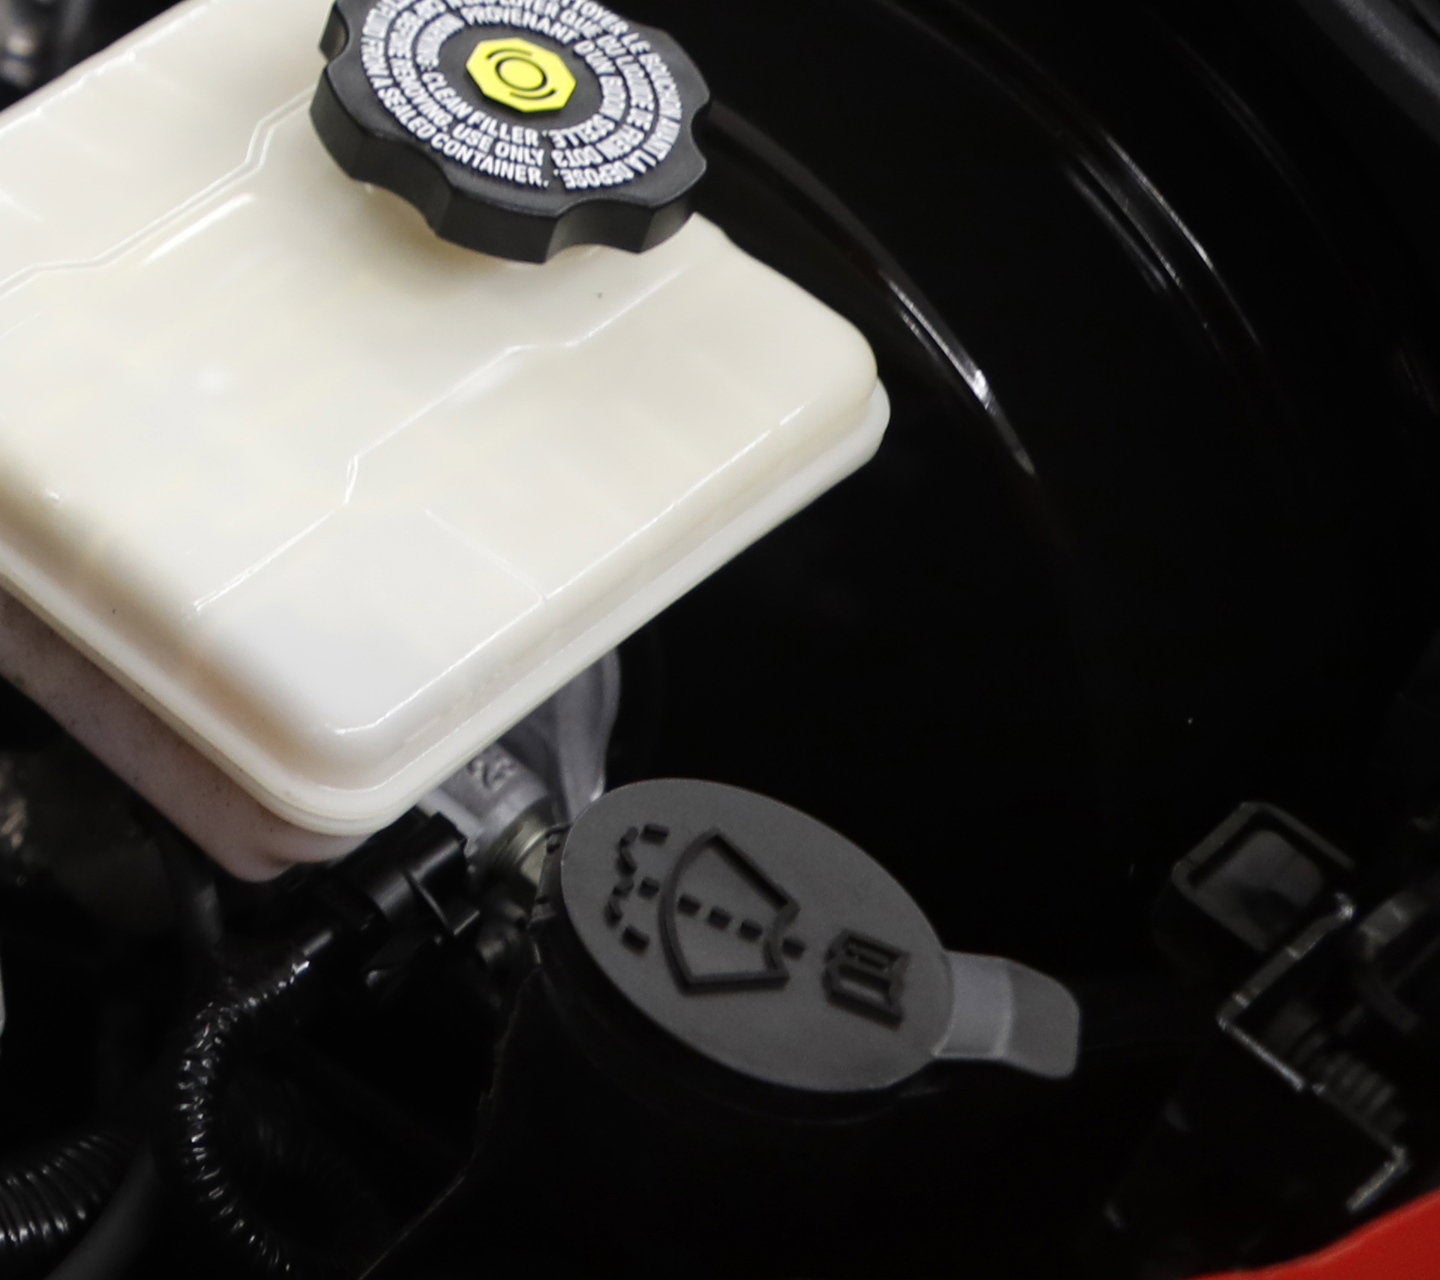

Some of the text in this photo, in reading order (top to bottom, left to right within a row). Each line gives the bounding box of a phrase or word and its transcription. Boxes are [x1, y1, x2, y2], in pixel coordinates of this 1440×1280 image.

[558, 5, 607, 39] QUE
[595, 33, 628, 57] DU
[620, 31, 652, 55] LE
[369, 75, 394, 89] A
[376, 86, 437, 139] SEALED
[421, 70, 543, 150] CLEAN FILLER
[446, 122, 494, 155] USE
[490, 140, 545, 168] ONLY
[622, 148, 657, 173] LA
